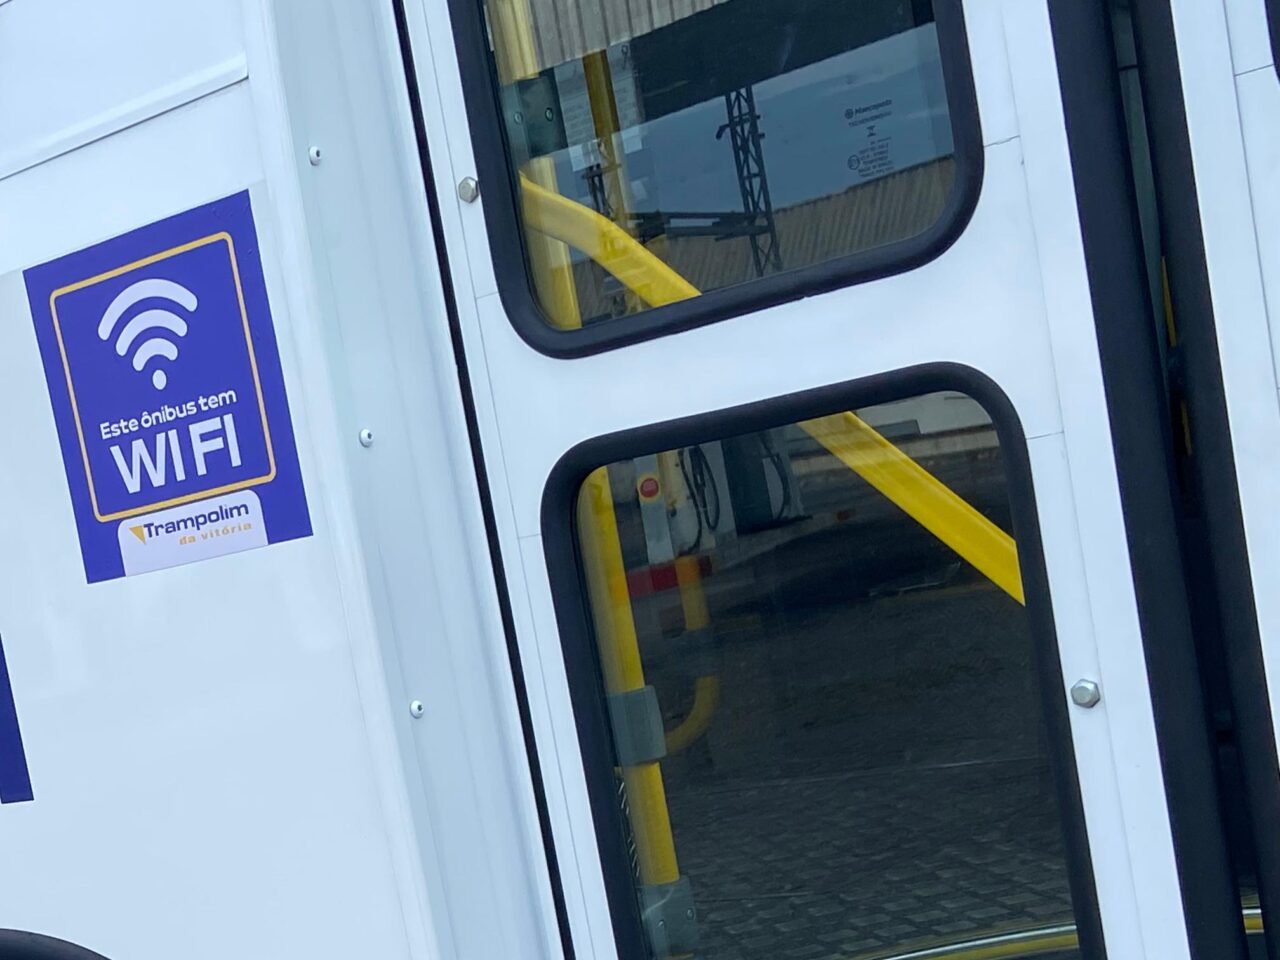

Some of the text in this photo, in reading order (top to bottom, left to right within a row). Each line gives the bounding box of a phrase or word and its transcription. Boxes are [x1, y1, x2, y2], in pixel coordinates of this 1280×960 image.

[100, 389, 238, 440] Este ônibus tem
[143, 503, 250, 538] Trampolim
[179, 522, 252, 546] da vitória
